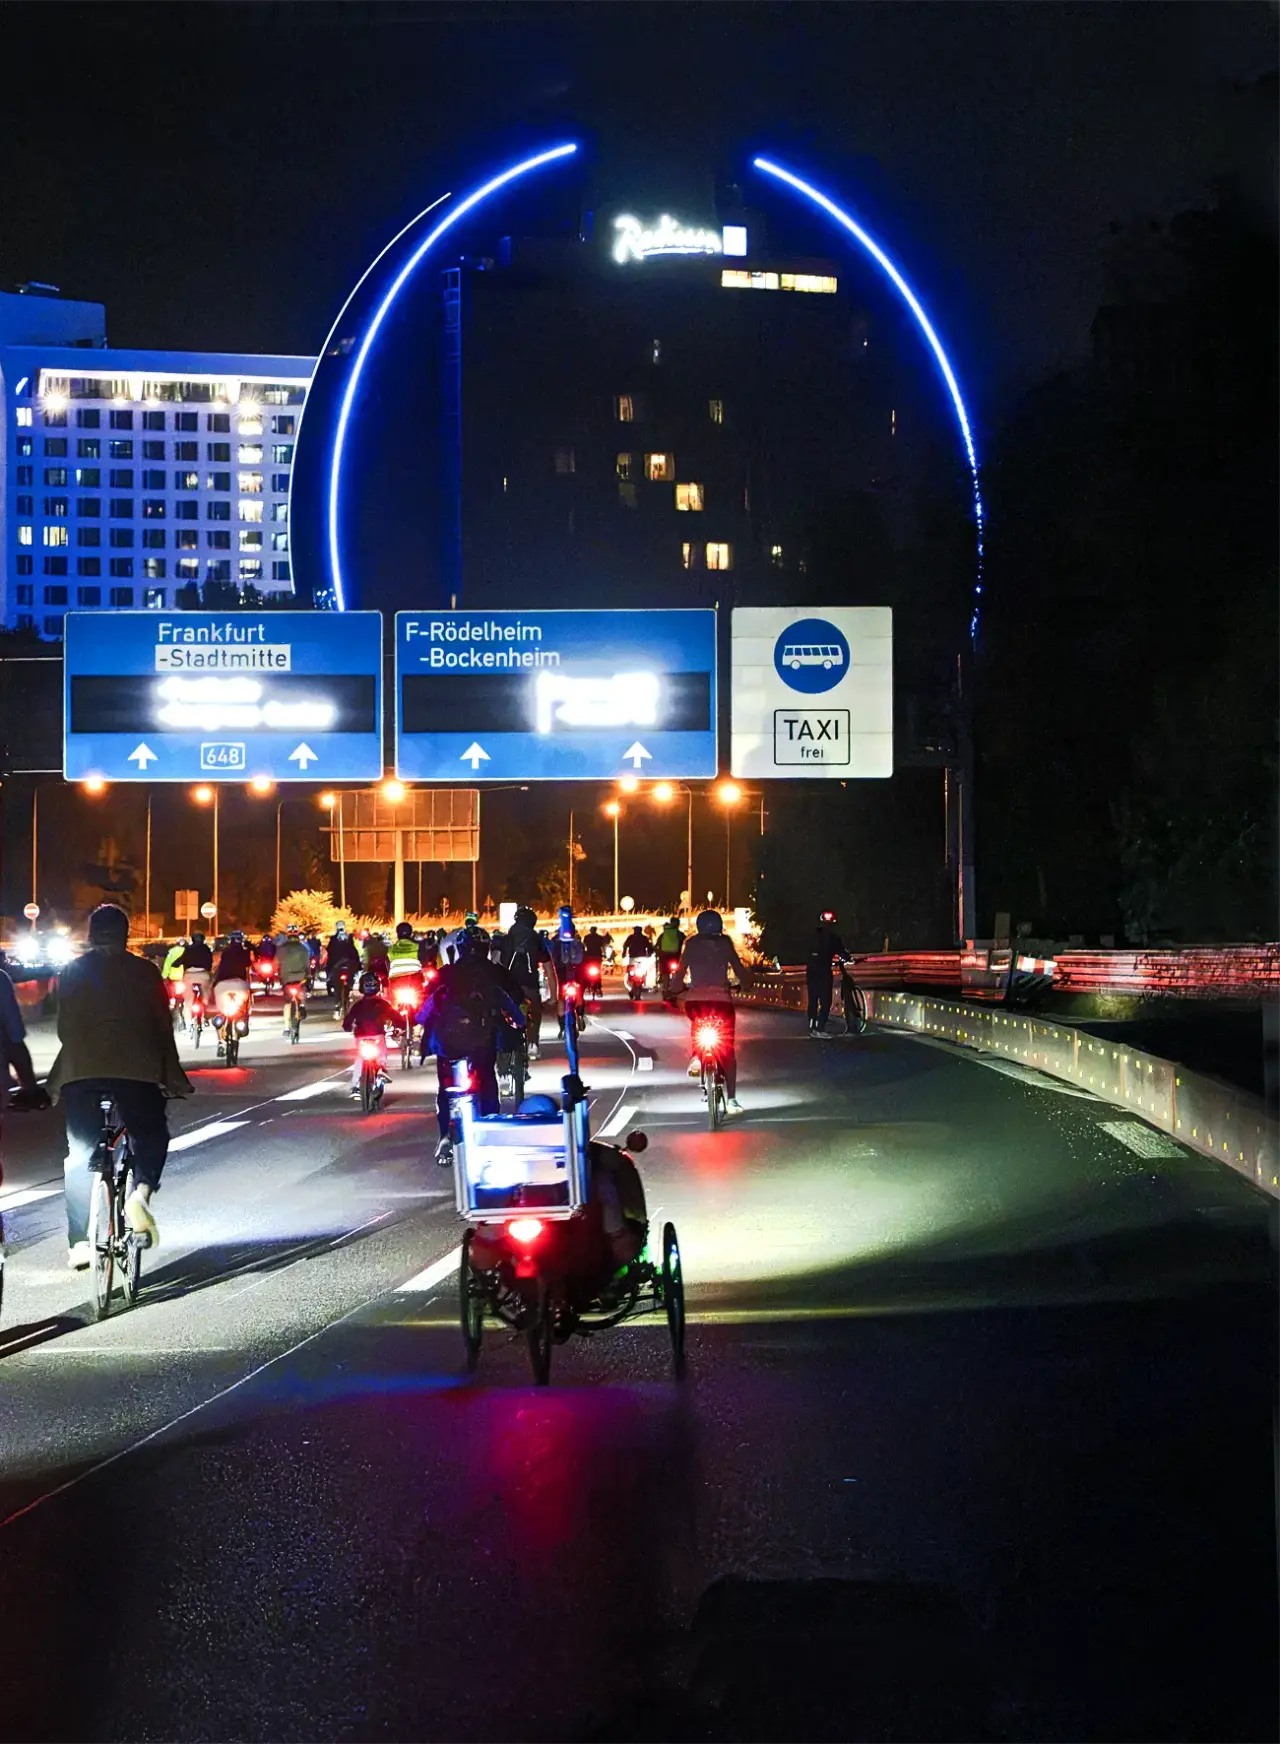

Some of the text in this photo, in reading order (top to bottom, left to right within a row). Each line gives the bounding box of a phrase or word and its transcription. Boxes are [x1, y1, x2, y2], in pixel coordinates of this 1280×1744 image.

[158, 622, 265, 642] Frankfurt
[406, 621, 542, 642] F-Rödelheim
[159, 648, 287, 667] -Stadtmitte
[420, 647, 560, 668] -Bockenheim
[783, 719, 839, 740] TAXI
[206, 747, 240, 764] 648
[800, 745, 824, 758] frei
